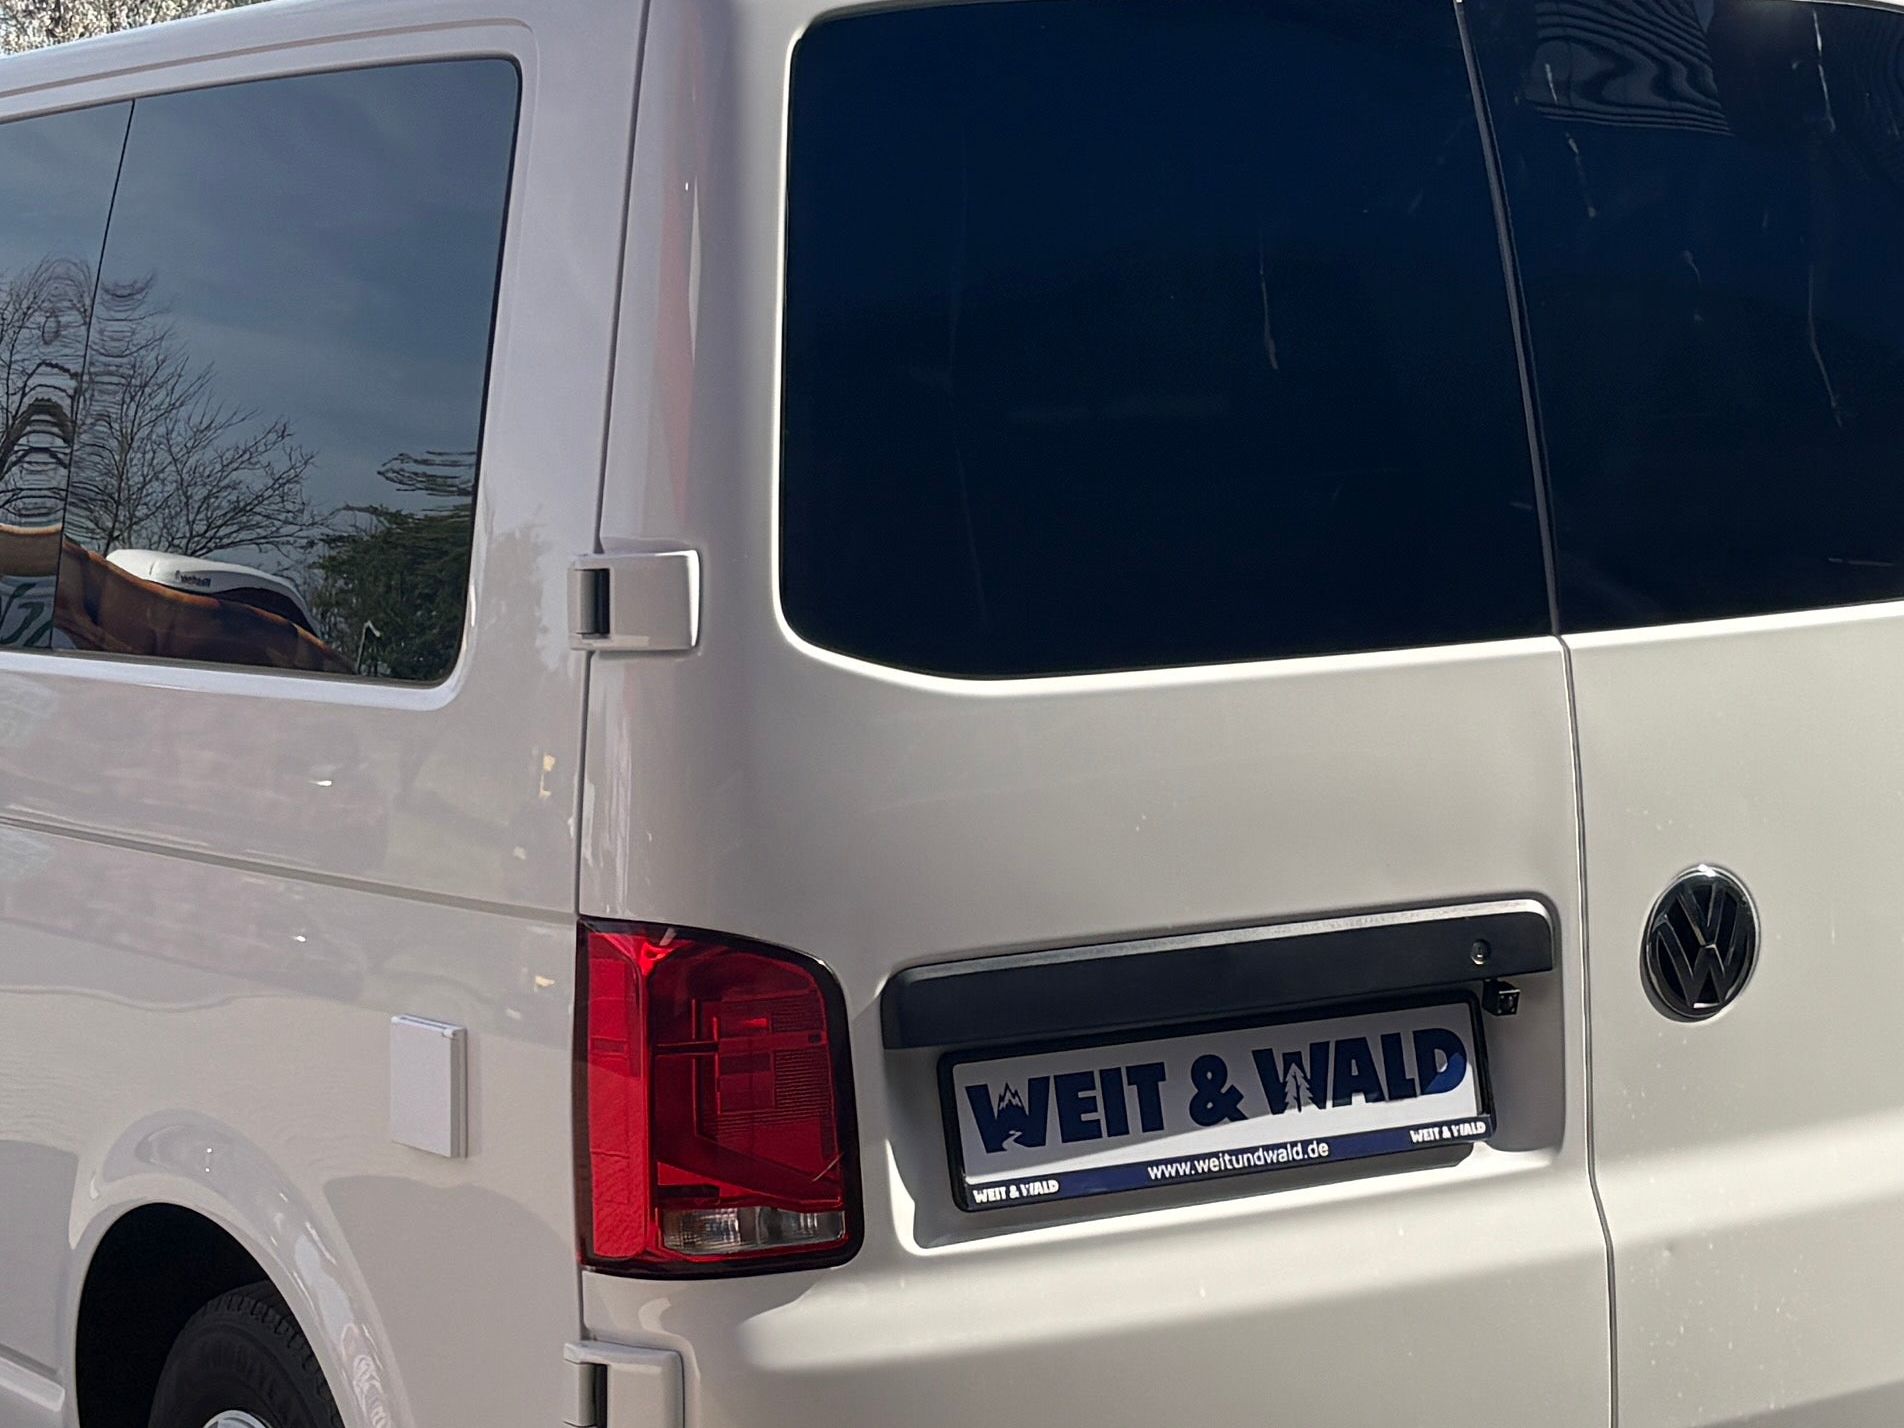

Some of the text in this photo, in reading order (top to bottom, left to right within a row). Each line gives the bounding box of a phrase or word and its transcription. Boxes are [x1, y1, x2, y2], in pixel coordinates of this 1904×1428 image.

[964, 1026, 1468, 1155] WEIT & WALD
[1409, 1120, 1487, 1143] WEIT & WALD
[1147, 1140, 1329, 1180] www.weitundwald.de
[972, 1179, 1060, 1203] WEIT & WALD
